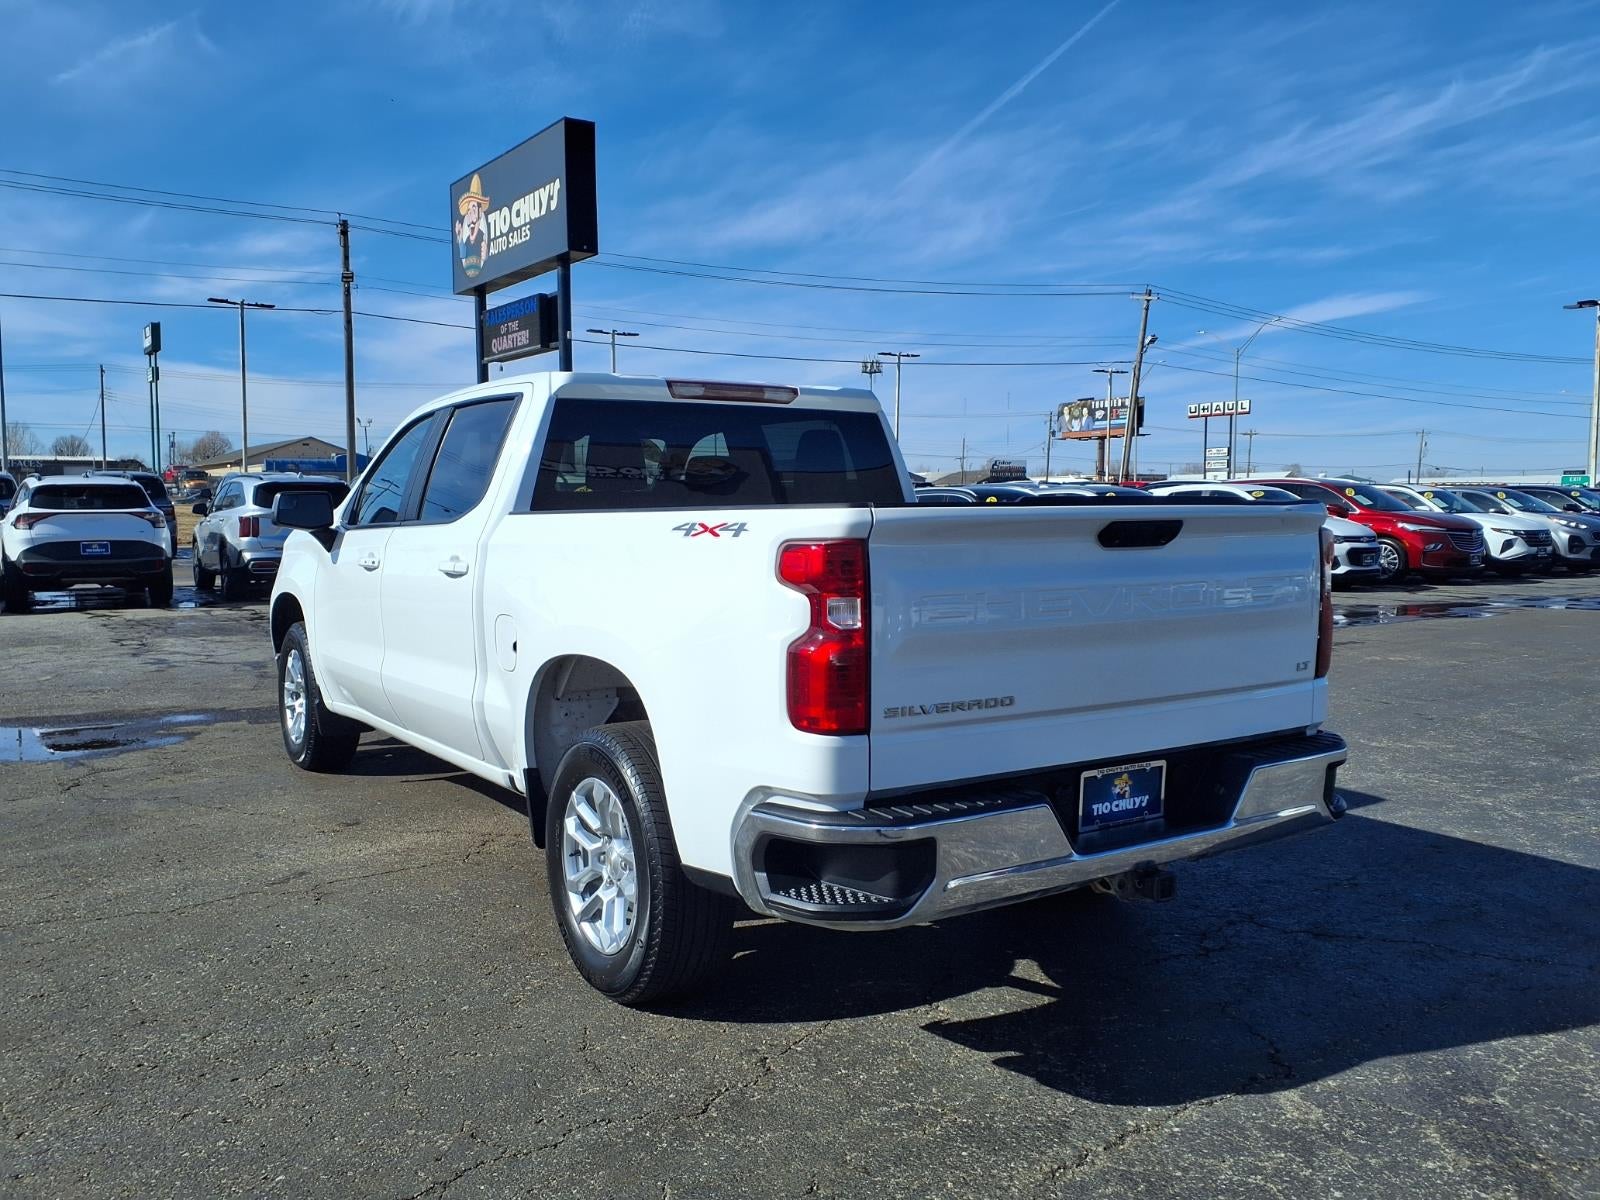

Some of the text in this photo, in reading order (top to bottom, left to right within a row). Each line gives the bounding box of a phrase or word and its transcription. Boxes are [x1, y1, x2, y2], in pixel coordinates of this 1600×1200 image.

[488, 178, 560, 239] TIO CHUY'S
[489, 224, 530, 256] AUTO SALES
[486, 298, 536, 327] SALESPERSON
[500, 320, 519, 335] OF THE
[491, 329, 529, 353] QUARTER!
[911, 574, 1308, 627] CHEVROLET
[1296, 660, 1311, 672] LT
[883, 696, 1015, 719] SILVERADO
[1092, 795, 1149, 816] TIO CHUY'S
